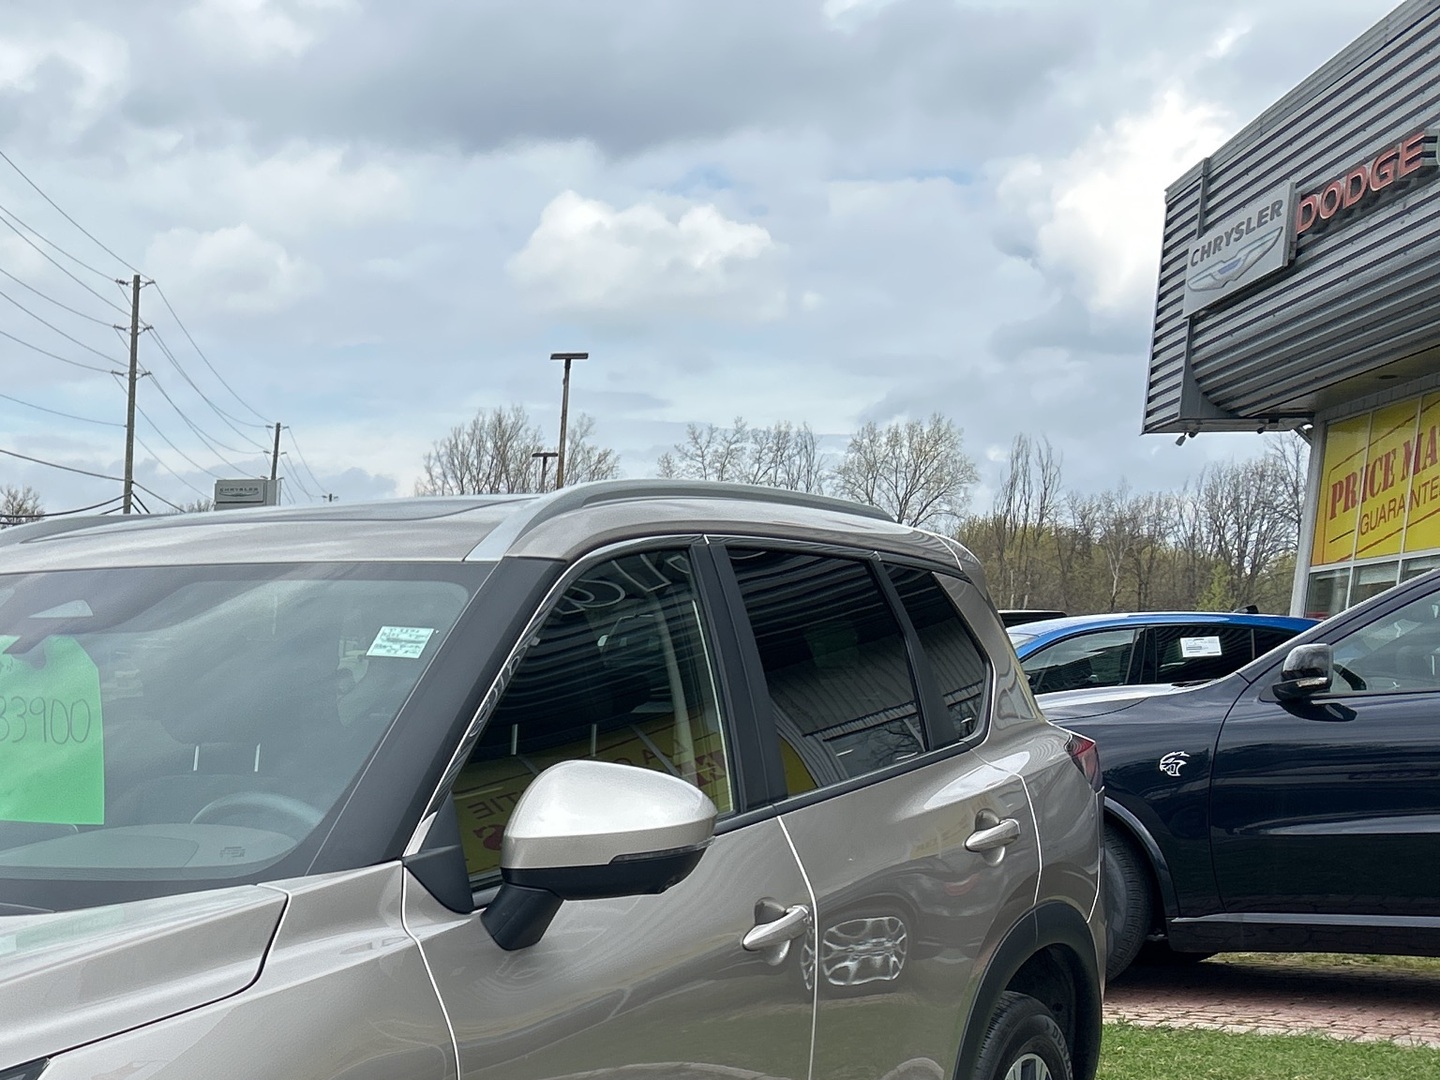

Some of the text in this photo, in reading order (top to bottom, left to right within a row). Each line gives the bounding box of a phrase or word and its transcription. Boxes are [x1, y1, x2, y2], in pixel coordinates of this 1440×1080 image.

[1296, 132, 1425, 234] DODGE
[1190, 199, 1283, 268] CHRYSLER
[1329, 425, 1440, 521] PRICE MA
[1360, 475, 1440, 535] GUARANTE
